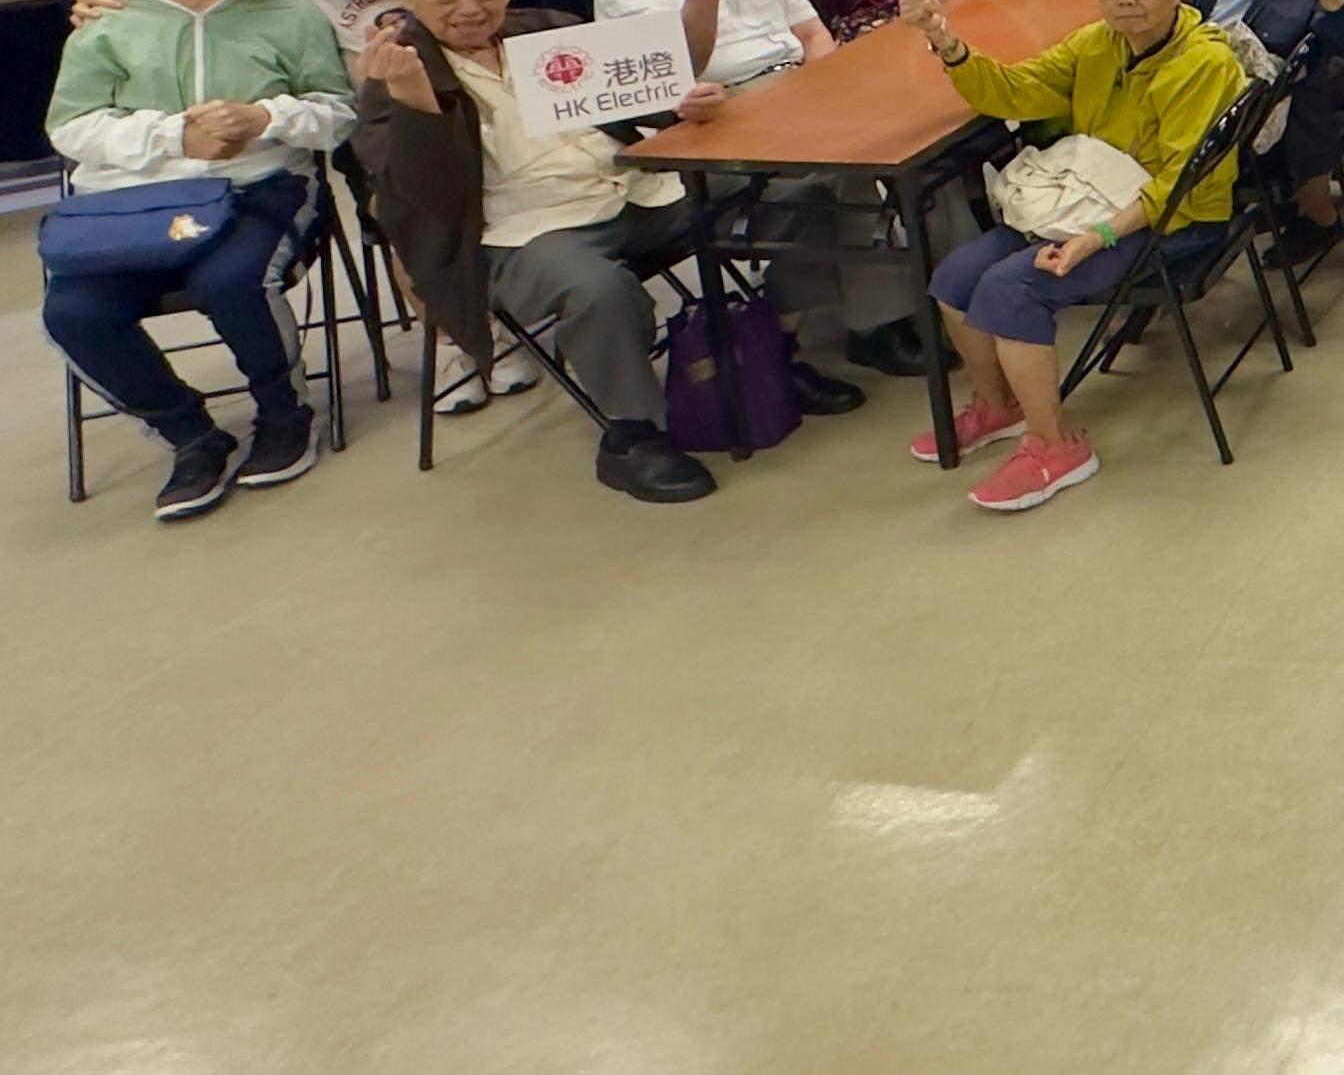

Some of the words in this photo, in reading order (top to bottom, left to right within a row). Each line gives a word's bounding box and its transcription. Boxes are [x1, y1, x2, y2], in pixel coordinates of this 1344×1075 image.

[603, 51, 677, 89] 港燈
[553, 97, 591, 121] HK
[596, 81, 682, 111] Electric
